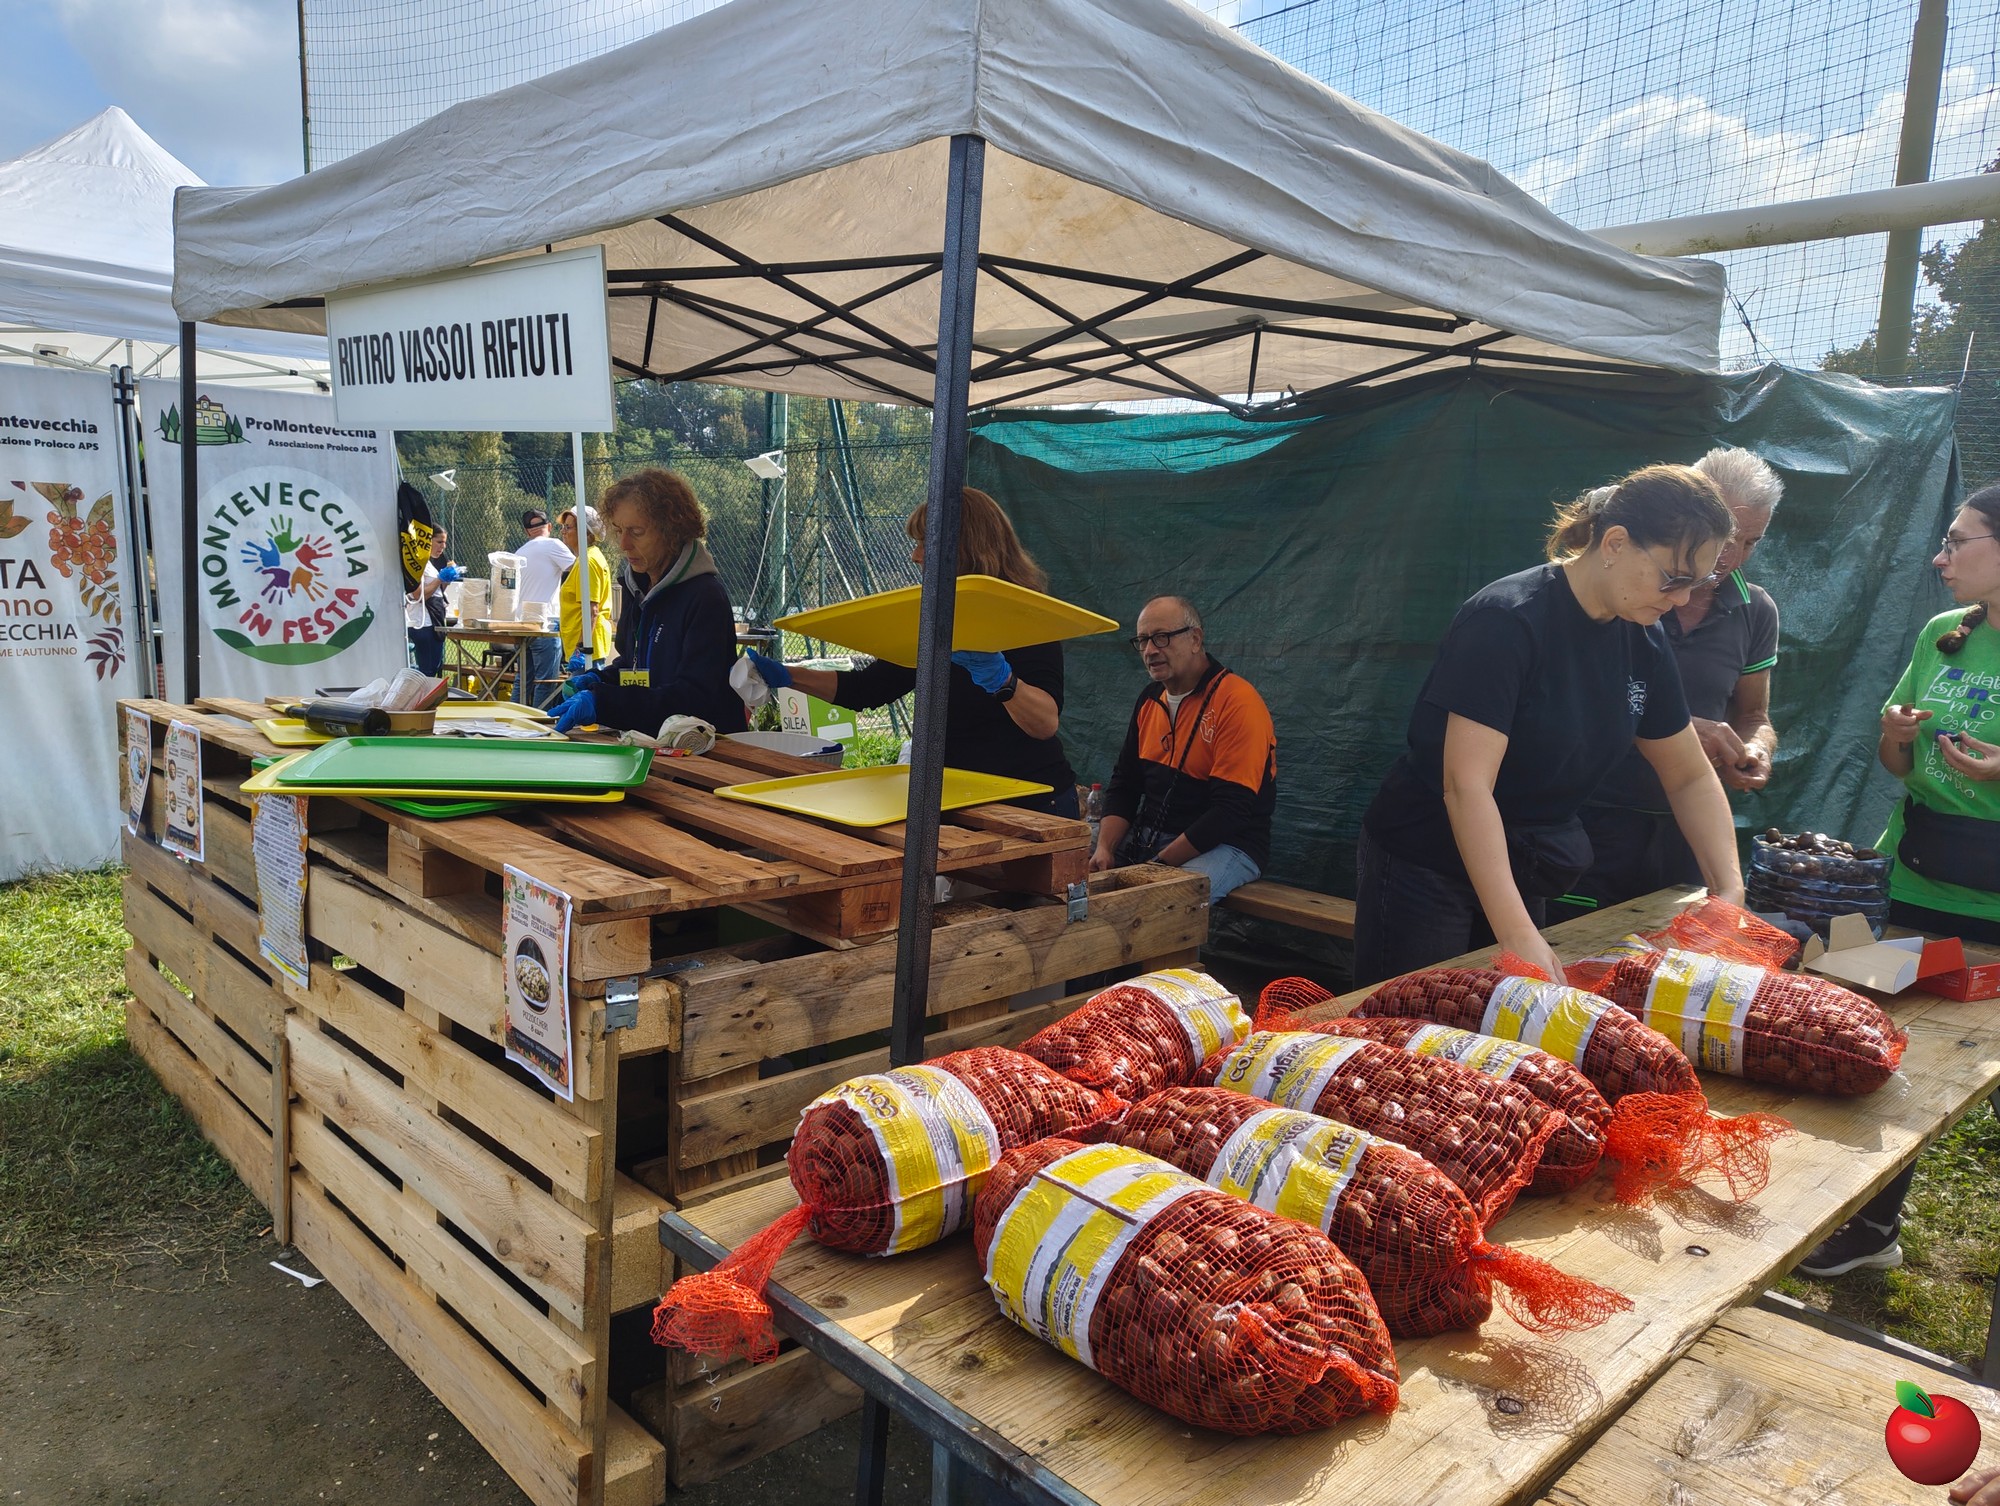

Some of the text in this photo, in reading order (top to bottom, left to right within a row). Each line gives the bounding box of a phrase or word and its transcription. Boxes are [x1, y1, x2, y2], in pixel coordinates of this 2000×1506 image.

[338, 313, 573, 386] RITIRO VASSOI RIFIUTI
[34, 438, 75, 449] Proloco
[78, 441, 99, 451] APS
[268, 439, 378, 454] Associazione Proloco APS
[202, 482, 369, 609] MONTEVECCHIA
[283, 588, 359, 644] FESTA
[16, 647, 77, 657] L'AUTUNNO
